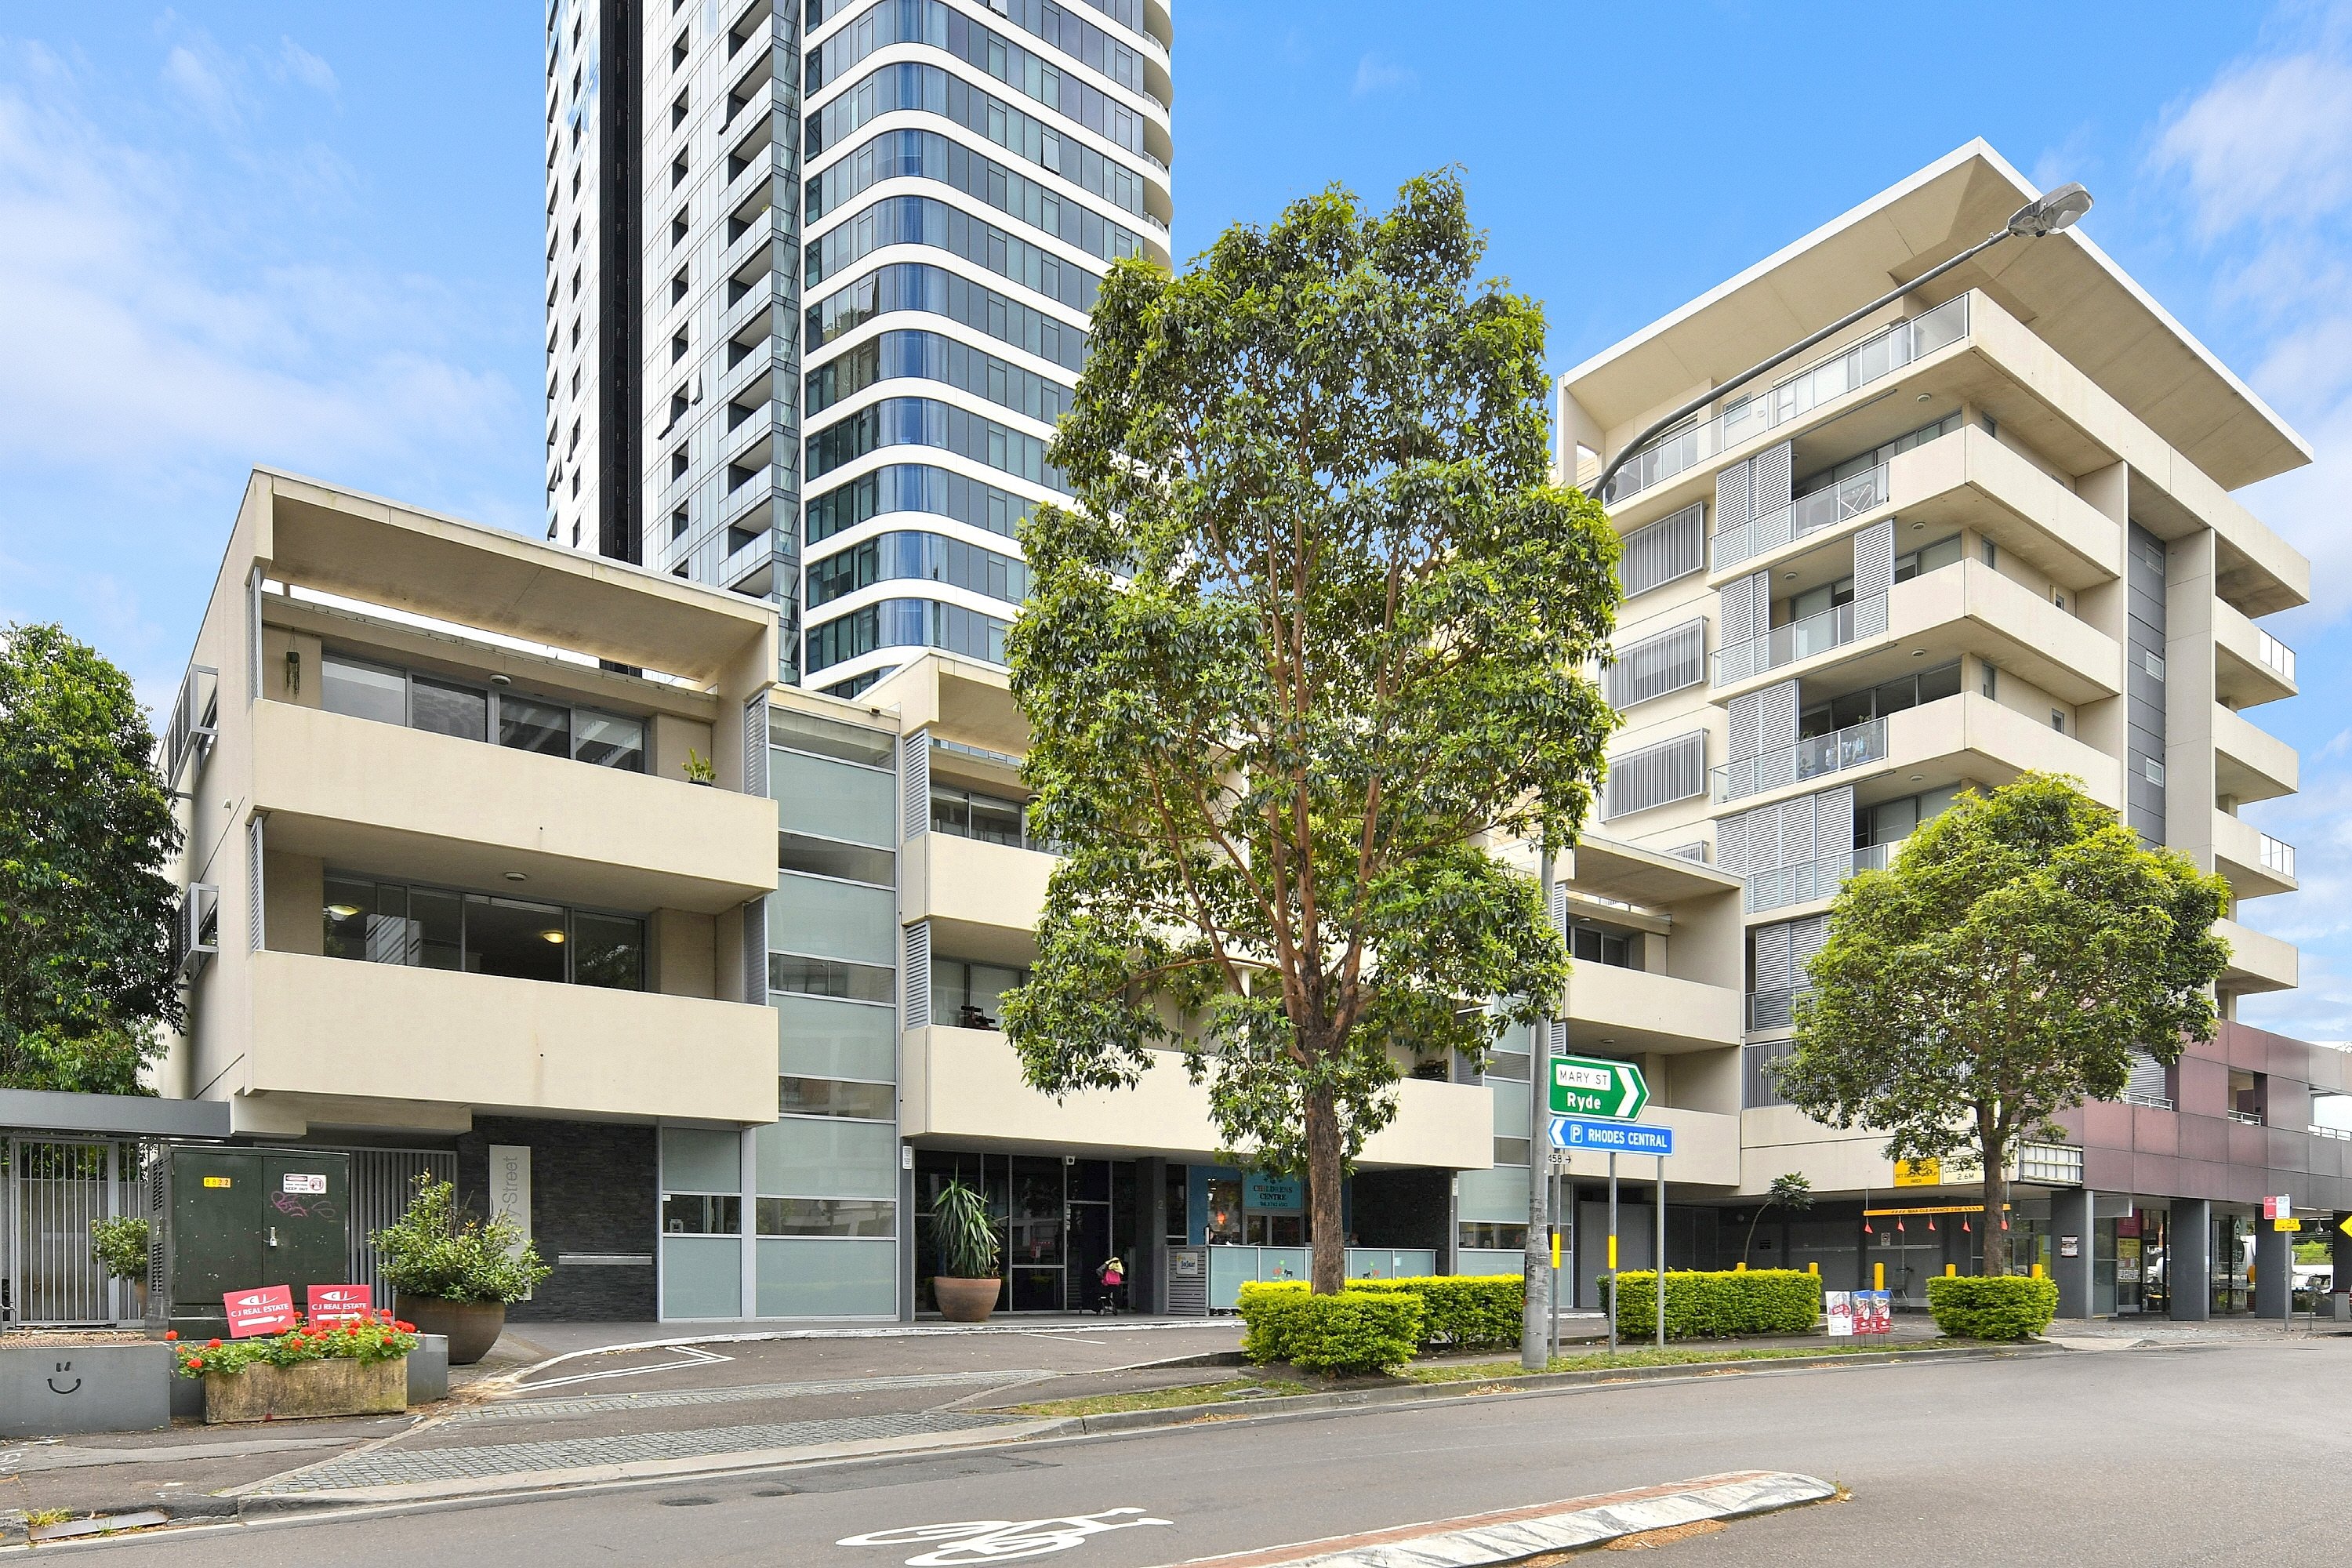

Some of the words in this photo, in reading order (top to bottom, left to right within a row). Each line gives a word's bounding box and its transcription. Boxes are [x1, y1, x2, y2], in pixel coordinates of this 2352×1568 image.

[1559, 1070, 1589, 1083] MARY
[1595, 1074, 1607, 1085] ST
[1566, 1091, 1602, 1112] Ryde
[1572, 1126, 1581, 1141] P
[1588, 1128, 1624, 1145] RHODES
[1628, 1132, 1668, 1148] CENTRAL
[502, 1156, 518, 1204] Street
[243, 1307, 262, 1316] REAL
[263, 1303, 289, 1312] ESTATE
